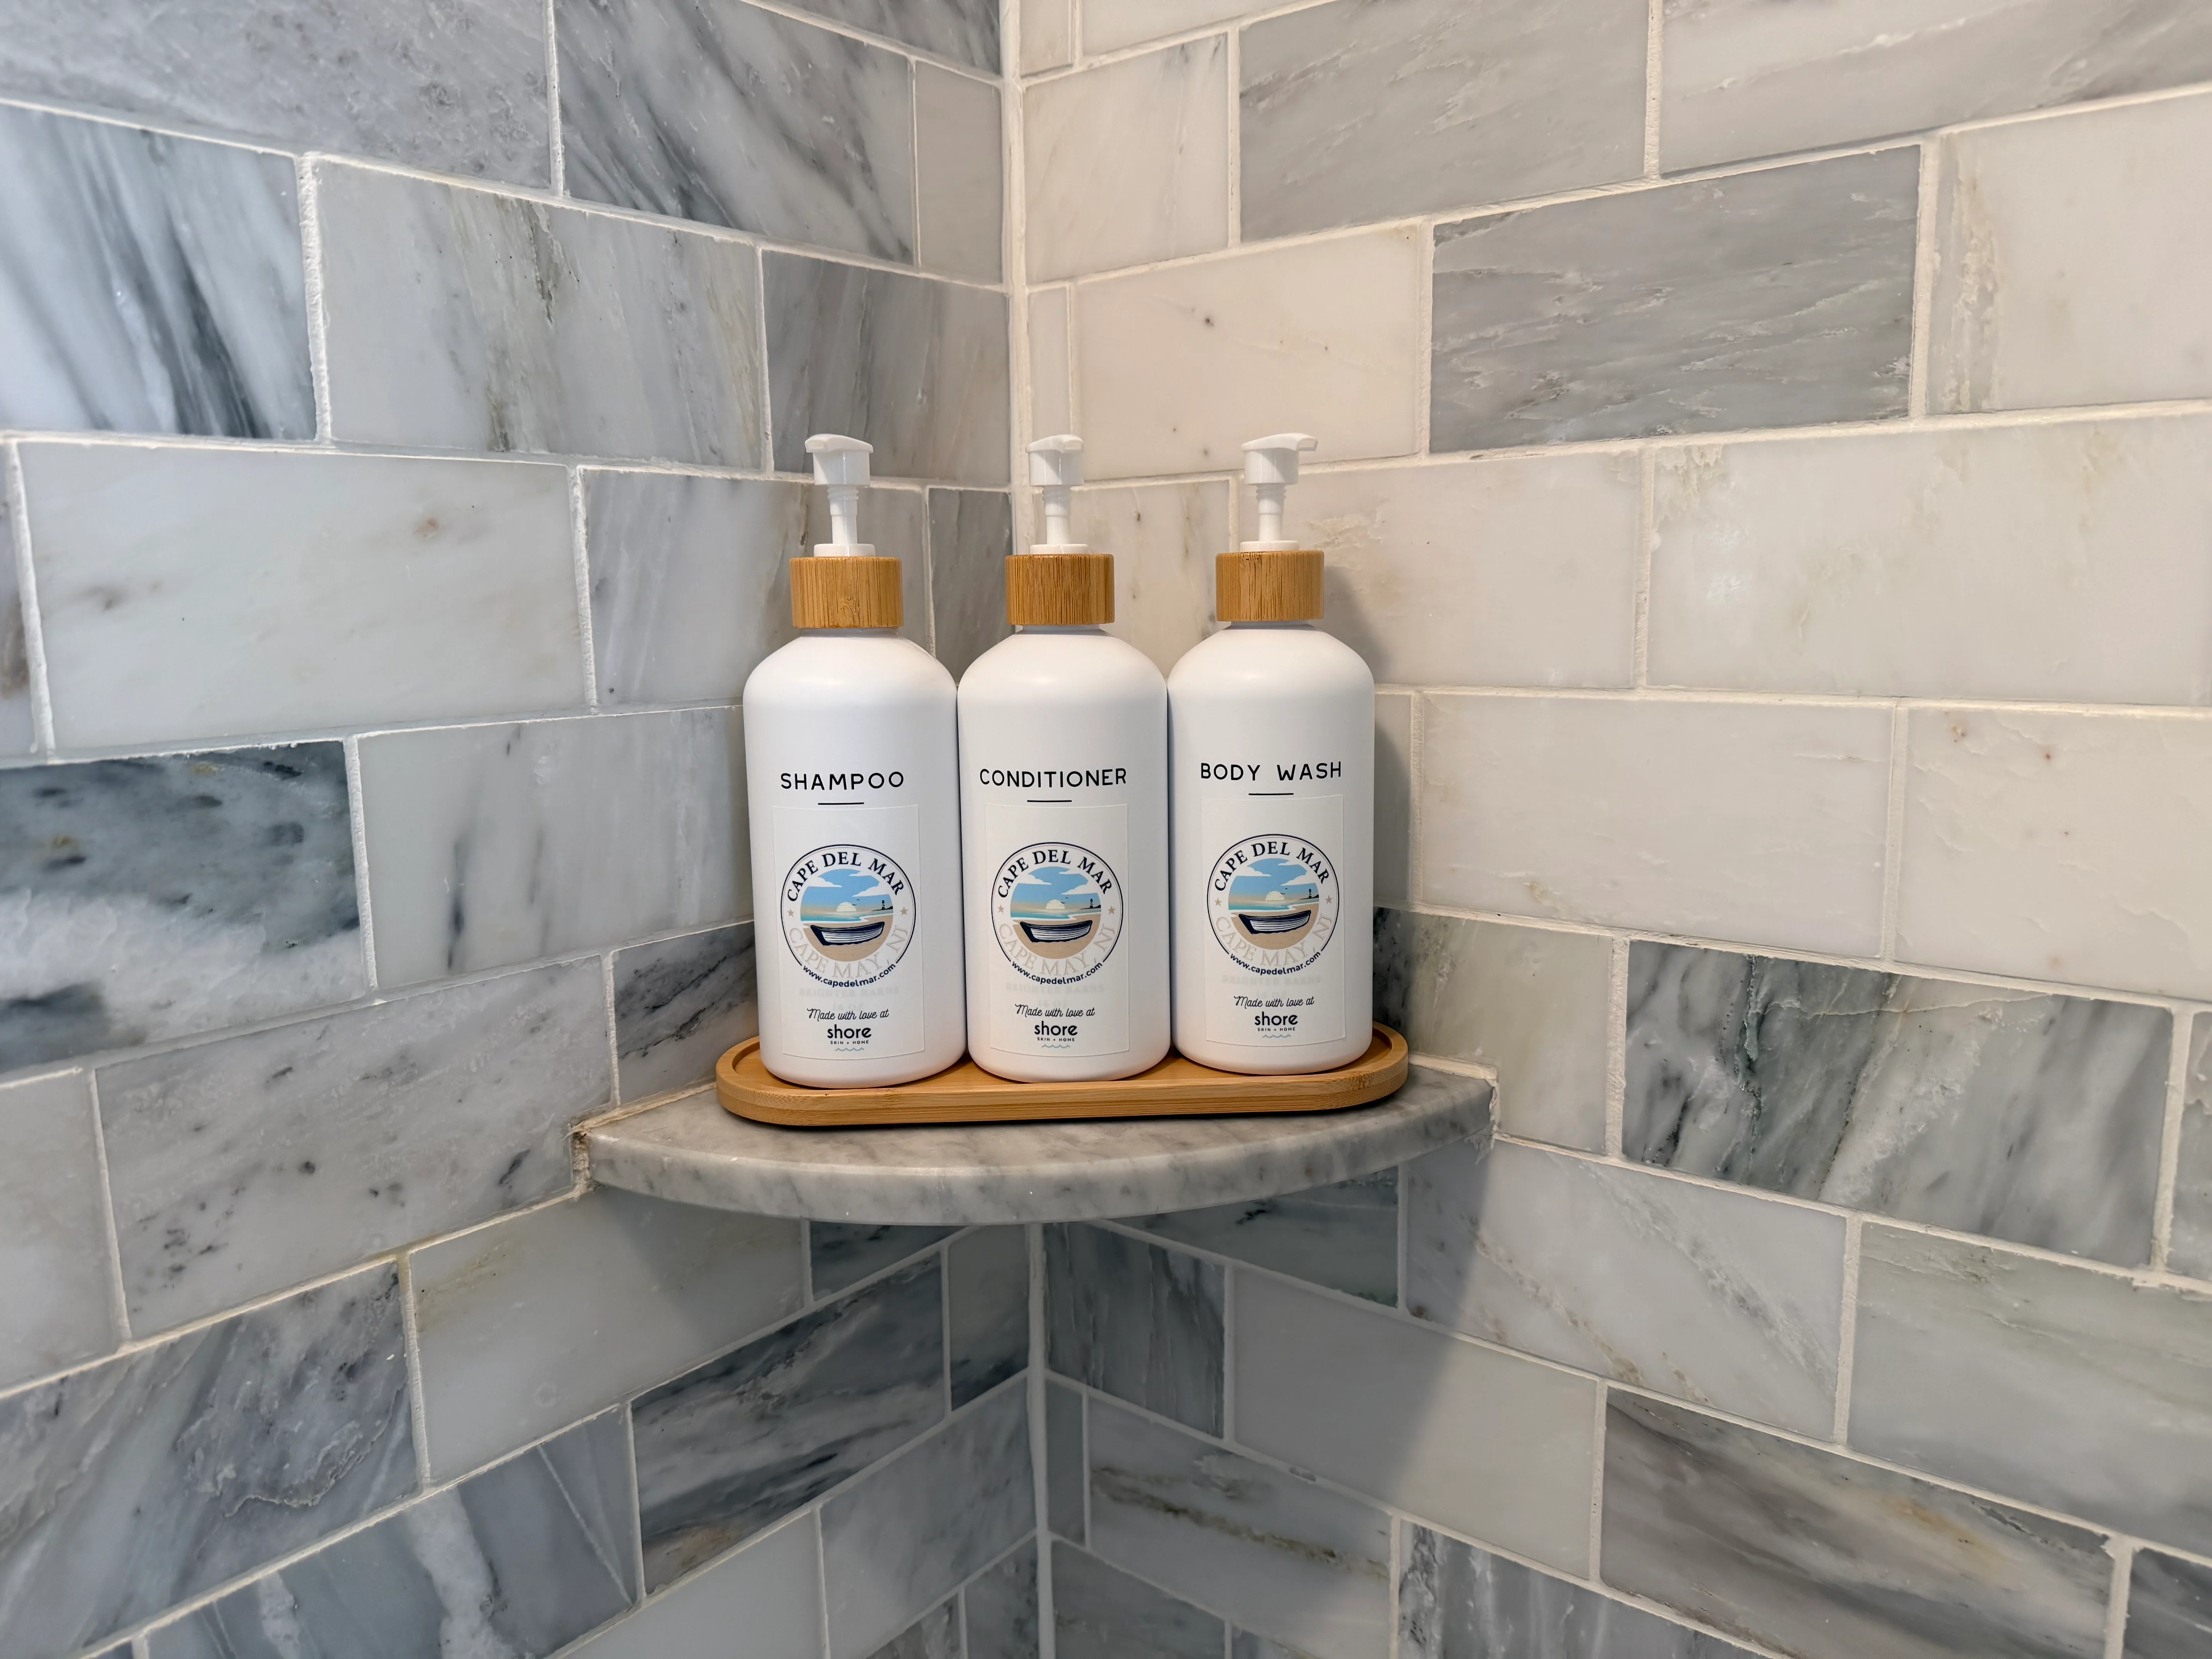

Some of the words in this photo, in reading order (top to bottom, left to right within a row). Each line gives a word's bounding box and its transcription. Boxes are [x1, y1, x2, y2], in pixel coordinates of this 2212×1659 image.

[781, 771, 904, 790] SHAMPOO
[980, 768, 1127, 788] CONDITIONER
[1200, 762, 1261, 781] BODY
[1277, 761, 1341, 781] WASH
[998, 857, 1029, 898] CAPE
[1032, 849, 1071, 864] DEL
[1077, 856, 1112, 894] MAR
[1214, 850, 1248, 891] CAPE
[1251, 841, 1290, 857] DEL
[1296, 847, 1329, 884] MAR
[787, 860, 819, 902] CAPE
[821, 852, 862, 867] DEL
[868, 858, 904, 896] MAR
[999, 924, 1037, 970] CAPE
[1216, 917, 1257, 962] CAPE
[789, 927, 829, 974] CAPE
[1012, 962, 1103, 985] www.capedelmar.com
[1230, 951, 1321, 975] www.capedelmar.com
[803, 963, 896, 988] www.capedelmar.com
[1015, 1004, 1042, 1018] Made
[1045, 1007, 1063, 1017] with
[1066, 1008, 1084, 1017] love
[1086, 1007, 1096, 1017] at
[1234, 996, 1263, 1009] Made
[1266, 998, 1284, 1007] with
[1286, 998, 1304, 1007] love
[1306, 996, 1315, 1006] at
[807, 1008, 836, 1022] Made
[838, 1010, 856, 1020] with
[859, 1010, 878, 1020] love
[880, 1008, 890, 1018] at
[1255, 1011, 1298, 1026] shore
[827, 1024, 872, 1039] shore
[1034, 1021, 1078, 1036] shore
